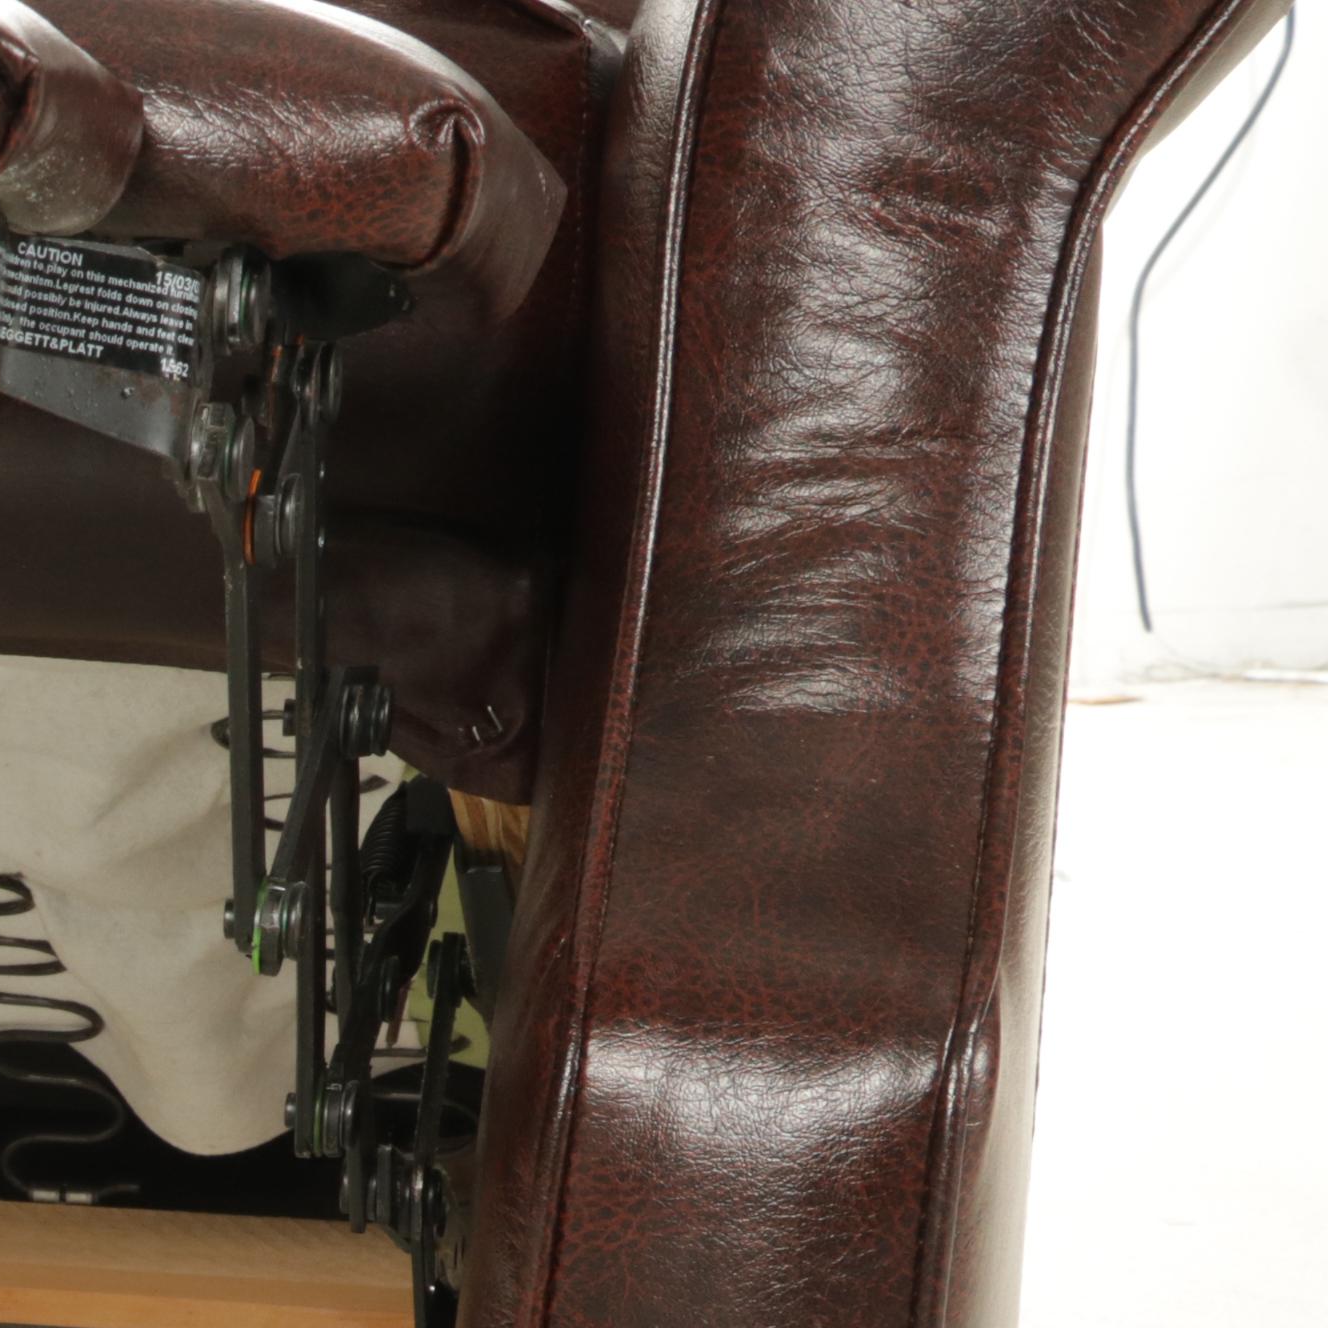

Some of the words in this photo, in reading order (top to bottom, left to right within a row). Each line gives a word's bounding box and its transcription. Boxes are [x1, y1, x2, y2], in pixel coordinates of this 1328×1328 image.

[18, 242, 84, 266] CAUTION
[33, 260, 45, 271] to
[46, 262, 68, 279] play
[70, 270, 85, 280] on
[86, 270, 106, 282] this
[108, 276, 169, 296] mechanized
[24, 289, 68, 307] possibly
[69, 297, 82, 308] be
[160, 314, 184, 330] leave
[97, 287, 123, 303] folds
[125, 293, 154, 307] down
[156, 300, 170, 311] on
[20, 317, 36, 329] the
[39, 322, 86, 339] occupant
[89, 331, 124, 346] should
[126, 338, 165, 353] operate
[101, 317, 134, 334] hands
[136, 326, 155, 338] and
[157, 329, 176, 342] feet
